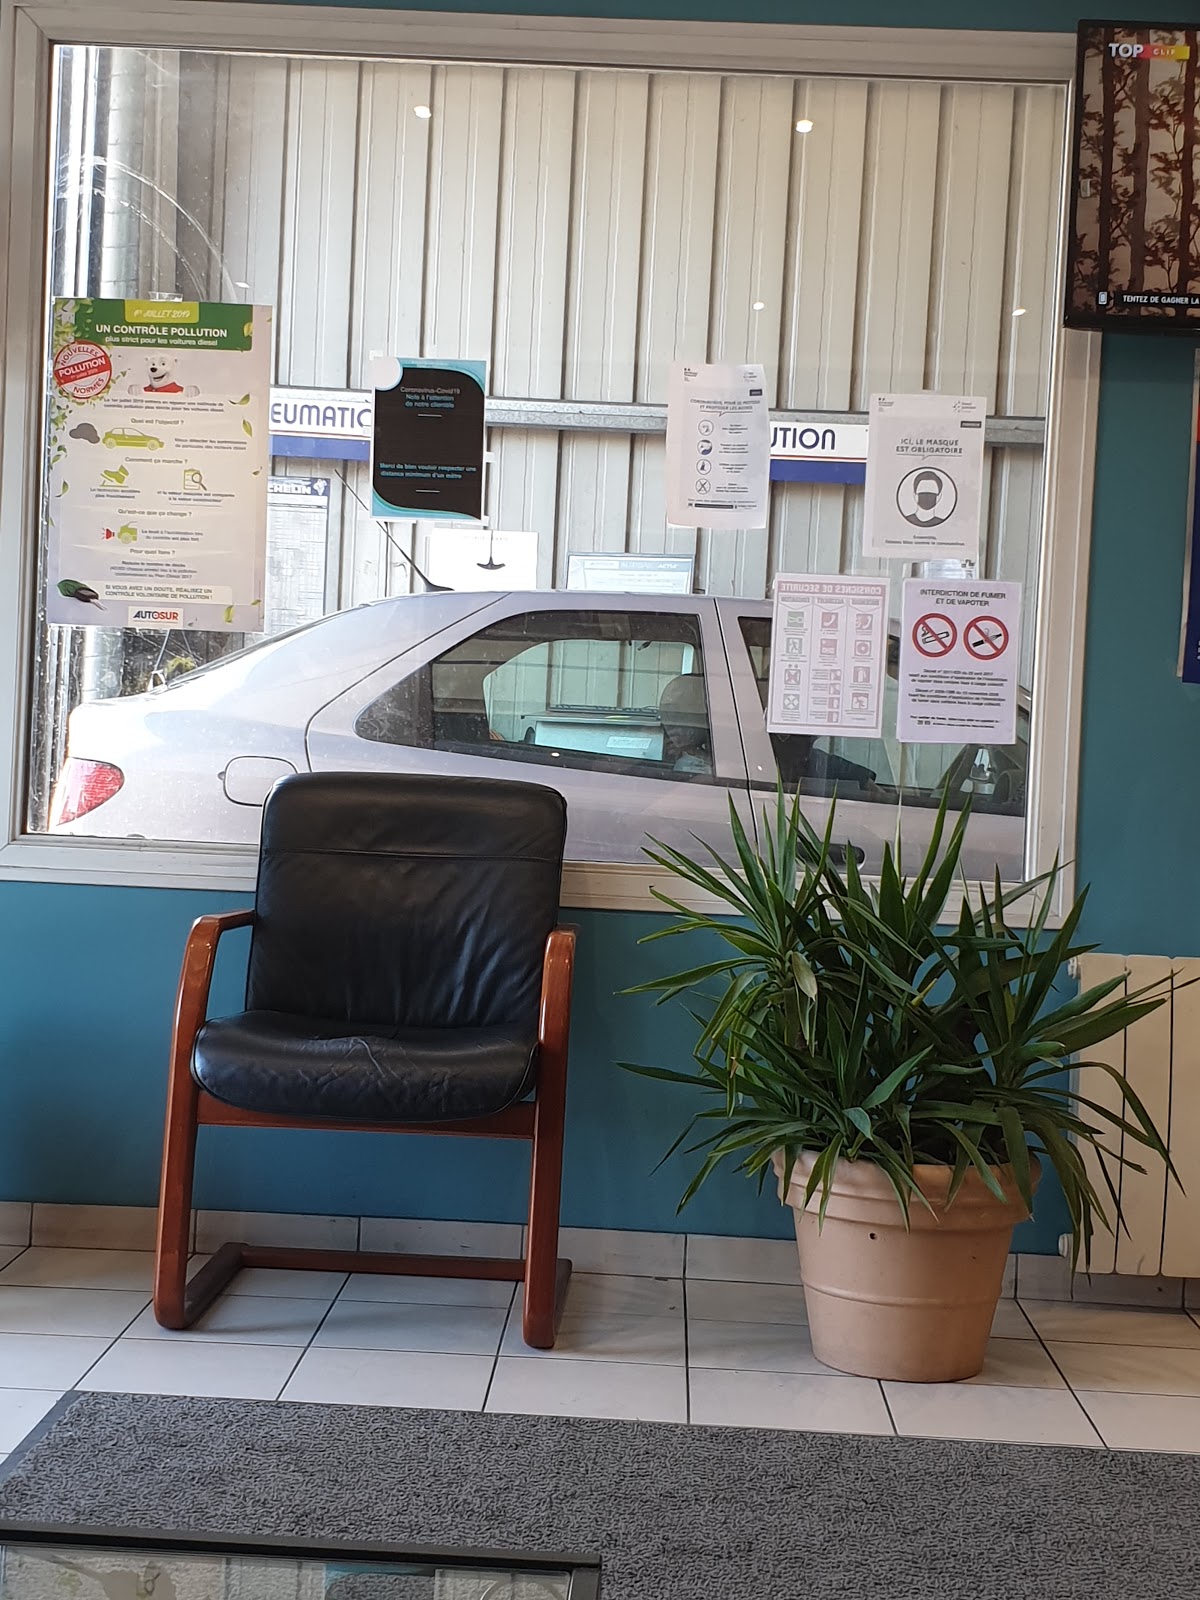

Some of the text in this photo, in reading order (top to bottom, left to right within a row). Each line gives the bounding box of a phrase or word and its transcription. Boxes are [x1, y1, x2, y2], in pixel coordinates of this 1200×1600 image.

[1108, 43, 1144, 58] TOP
[1123, 295, 1148, 303] TENTEZ
[1161, 296, 1188, 304] GAGNER
[172, 310, 190, 318] 2019
[96, 324, 227, 338] UN CONTRÔLE POLLUTION
[105, 336, 120, 344] plus
[170, 338, 196, 346] voitures
[61, 346, 99, 366] NOUVELLES
[59, 358, 106, 377] POLLUTION
[73, 378, 104, 394] NORMES
[911, 446, 963, 454] OBLIGATOIRE
[920, 589, 969, 597] INTERDICTION
[133, 611, 179, 620] AUTOSUR
